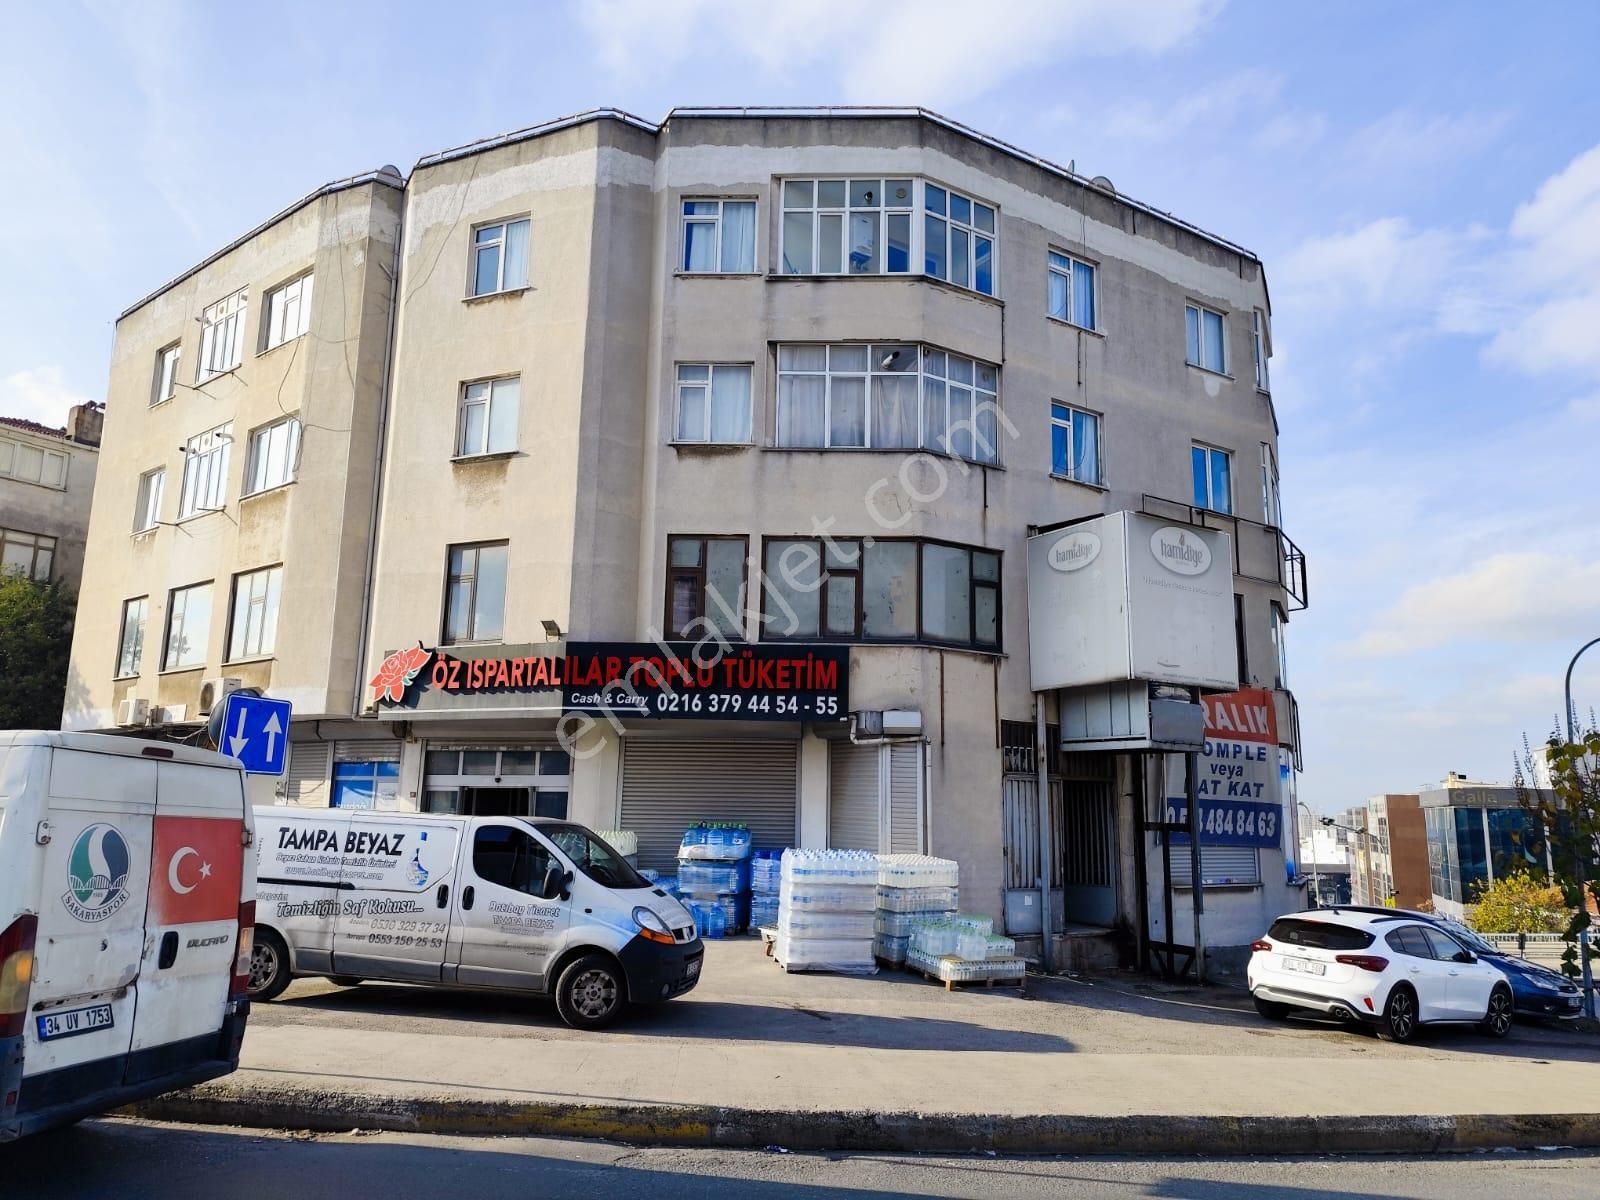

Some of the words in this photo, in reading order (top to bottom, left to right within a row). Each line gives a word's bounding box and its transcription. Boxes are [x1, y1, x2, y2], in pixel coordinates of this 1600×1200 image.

[431, 651, 462, 689] ÖZ
[466, 655, 622, 689] ISPARTALILAR
[628, 655, 714, 688] TOPLU
[722, 649, 837, 689] TÜKETİM
[571, 692, 600, 704] Cash
[616, 693, 649, 707] Carry
[657, 693, 702, 712] 0216
[708, 694, 742, 713] 379
[748, 695, 770, 713] 44
[776, 695, 798, 714] 54
[815, 696, 838, 715] 55
[1200, 701, 1270, 735] RALIK
[1203, 742, 1267, 762] OMPLE
[1210, 763, 1244, 780] veya
[1198, 779, 1221, 795] AT
[1228, 781, 1264, 797] KAT
[1206, 808, 1234, 834] 484
[1236, 809, 1255, 835] 84
[1258, 811, 1276, 837] 63
[278, 827, 339, 853] TAMPA
[343, 830, 405, 856] BEYAZ
[65, 893, 126, 921] SAKARYASPOR
[277, 898, 341, 918] Temizliğin
[343, 900, 368, 918] Saf
[370, 918, 395, 931] 0530
[418, 922, 433, 934] 37
[433, 923, 447, 935] 34
[493, 915, 523, 927] TAMPA
[525, 918, 554, 930] BEYAZ
[187, 934, 229, 948] DUCATO
[368, 932, 392, 945] 0553
[394, 935, 414, 946] 150
[415, 936, 429, 948] 25
[430, 938, 443, 949] 53
[46, 1016, 60, 1034] 34
[66, 1012, 78, 1030] UV
[86, 1007, 110, 1026] 1753
